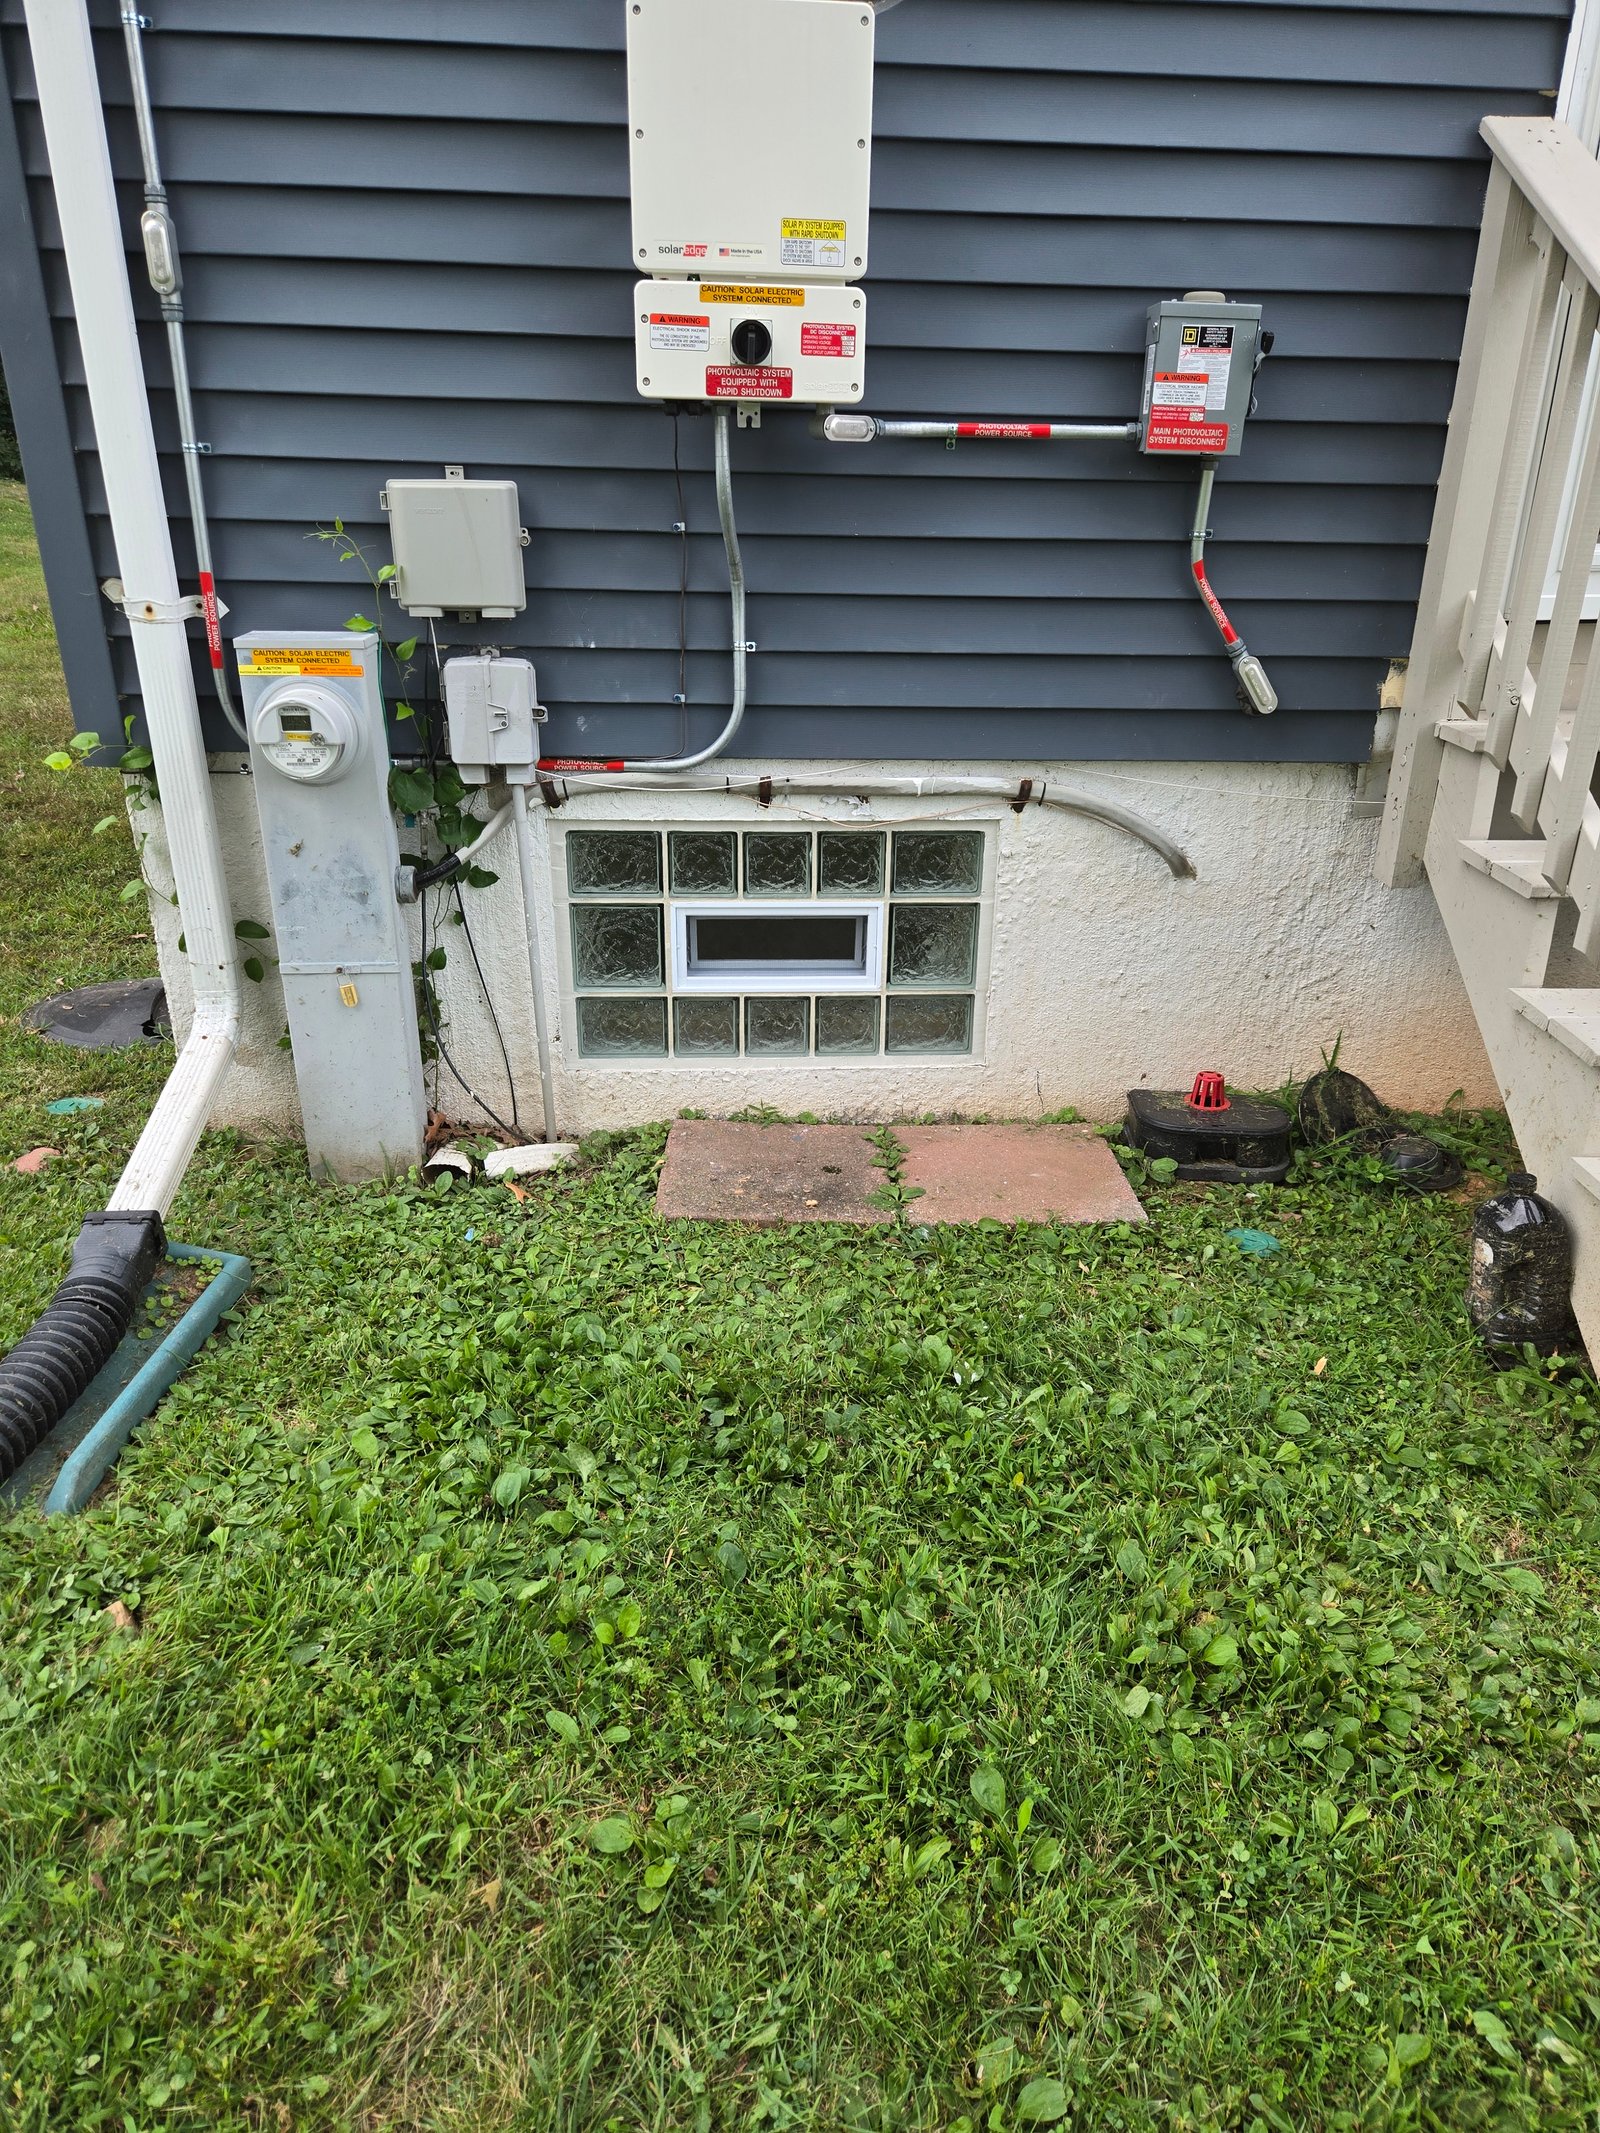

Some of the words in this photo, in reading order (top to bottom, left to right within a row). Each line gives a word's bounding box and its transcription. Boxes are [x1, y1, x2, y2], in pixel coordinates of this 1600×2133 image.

[782, 220, 798, 228] SOLAR
[798, 221, 804, 229] PV
[805, 221, 822, 230] SYSTEM
[823, 222, 844, 231] EQUIPPED
[801, 230, 814, 238] RAPID
[814, 230, 839, 239] SHUTDOWN
[658, 244, 708, 257] solaredge
[701, 285, 736, 293] CAUTION:
[738, 286, 764, 295] SOLAR
[767, 288, 803, 296] ELECTRIC
[712, 294, 743, 302] SYSTEM
[745, 296, 792, 304] CONNECTED
[668, 316, 701, 324] WARNING
[707, 367, 760, 377] PHOTOVOLTAIC
[762, 369, 792, 377] SYSTEM
[721, 378, 757, 386] EQUIPPED
[717, 387, 738, 396] RAPID
[740, 388, 782, 396] SHUTDOWN
[1153, 427, 1171, 435] MAIN
[1172, 428, 1223, 437] PHOTOVOLTAIC
[1149, 436, 1178, 444] SYSTEM
[1180, 437, 1225, 446] DISCONNECT
[207, 592, 217, 622] SOURCE
[1200, 578, 1214, 602] POWER
[1210, 602, 1226, 629] SOURCE
[212, 624, 220, 651] POWER
